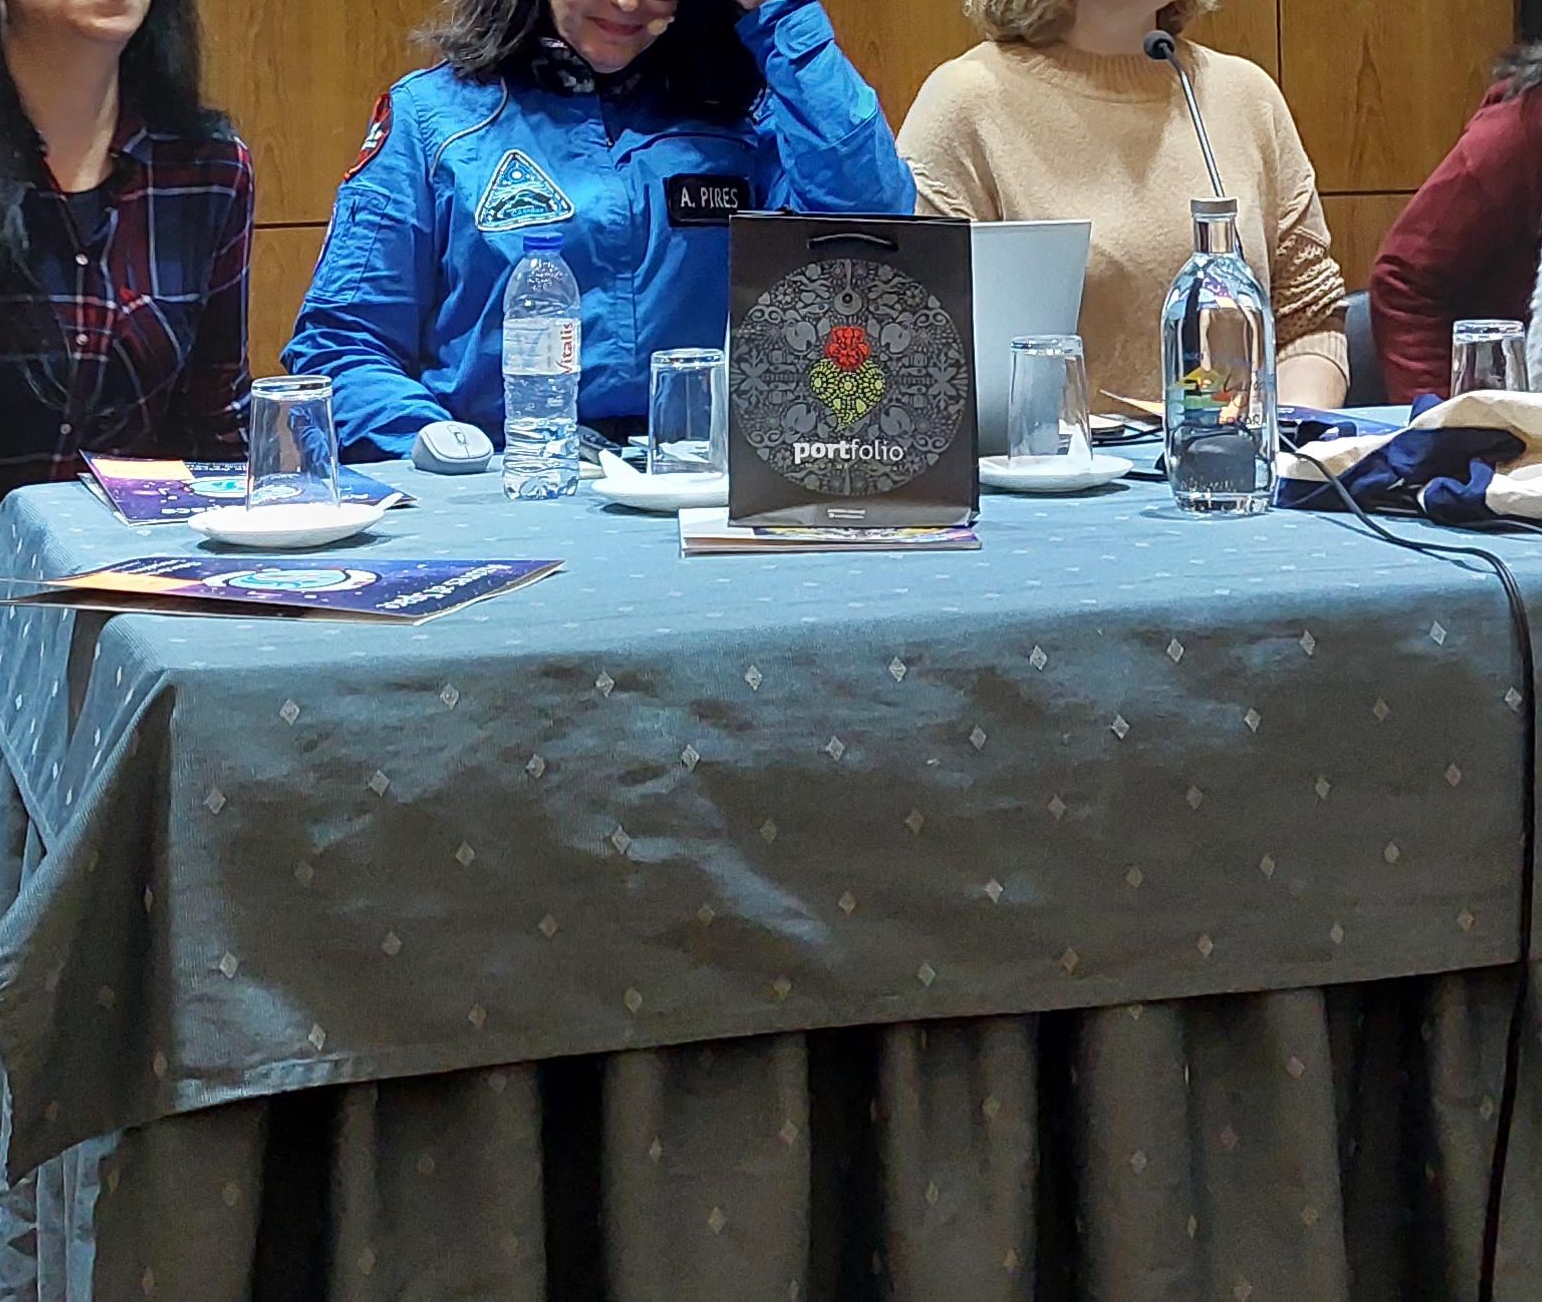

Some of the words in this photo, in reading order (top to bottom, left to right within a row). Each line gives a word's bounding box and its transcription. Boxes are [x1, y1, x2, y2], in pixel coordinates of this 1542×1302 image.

[680, 186, 696, 208] A.
[700, 186, 739, 209] PIRES
[555, 322, 574, 375] Vitalis
[792, 438, 905, 465] portfolio
